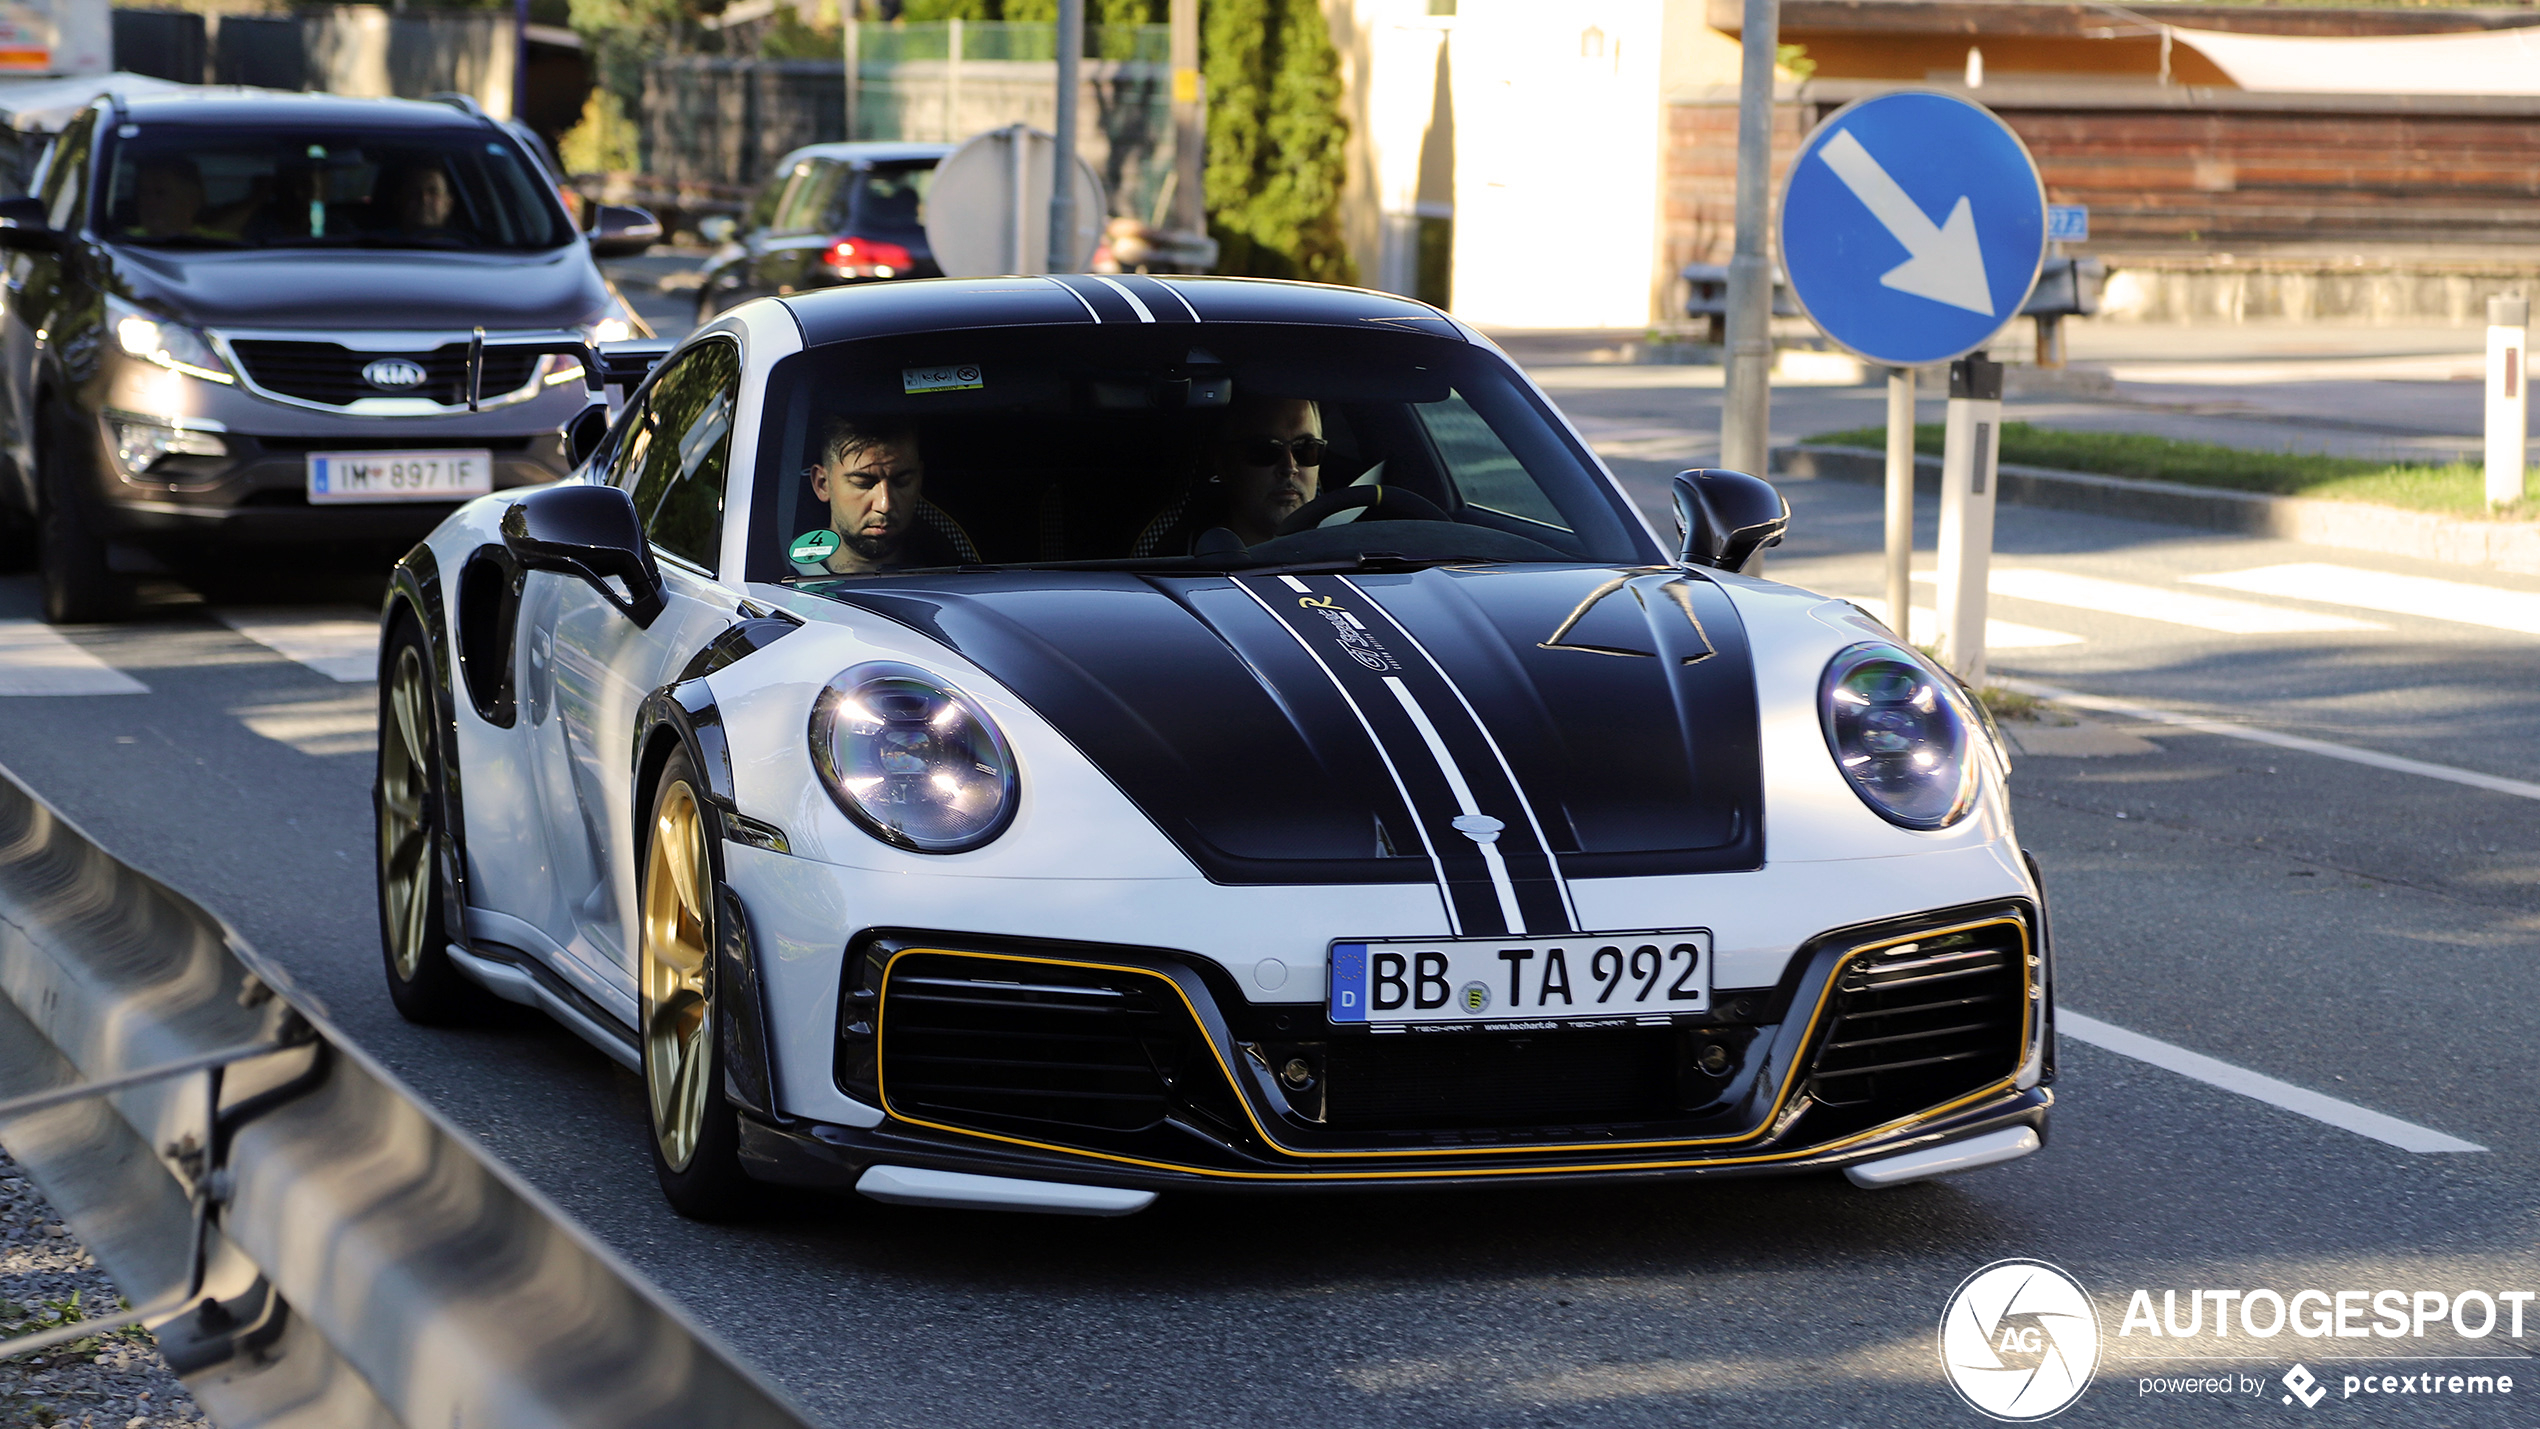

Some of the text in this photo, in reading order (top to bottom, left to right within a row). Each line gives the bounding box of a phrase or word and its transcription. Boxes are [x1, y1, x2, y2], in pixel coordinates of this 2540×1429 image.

[372, 363, 418, 385] KIA
[341, 459, 472, 488] IM 897 IF
[808, 531, 823, 546] 4
[1341, 943, 1699, 1010] D BB TA 992
[1412, 1019, 1628, 1033] TECHART www.techart.de TECHART
